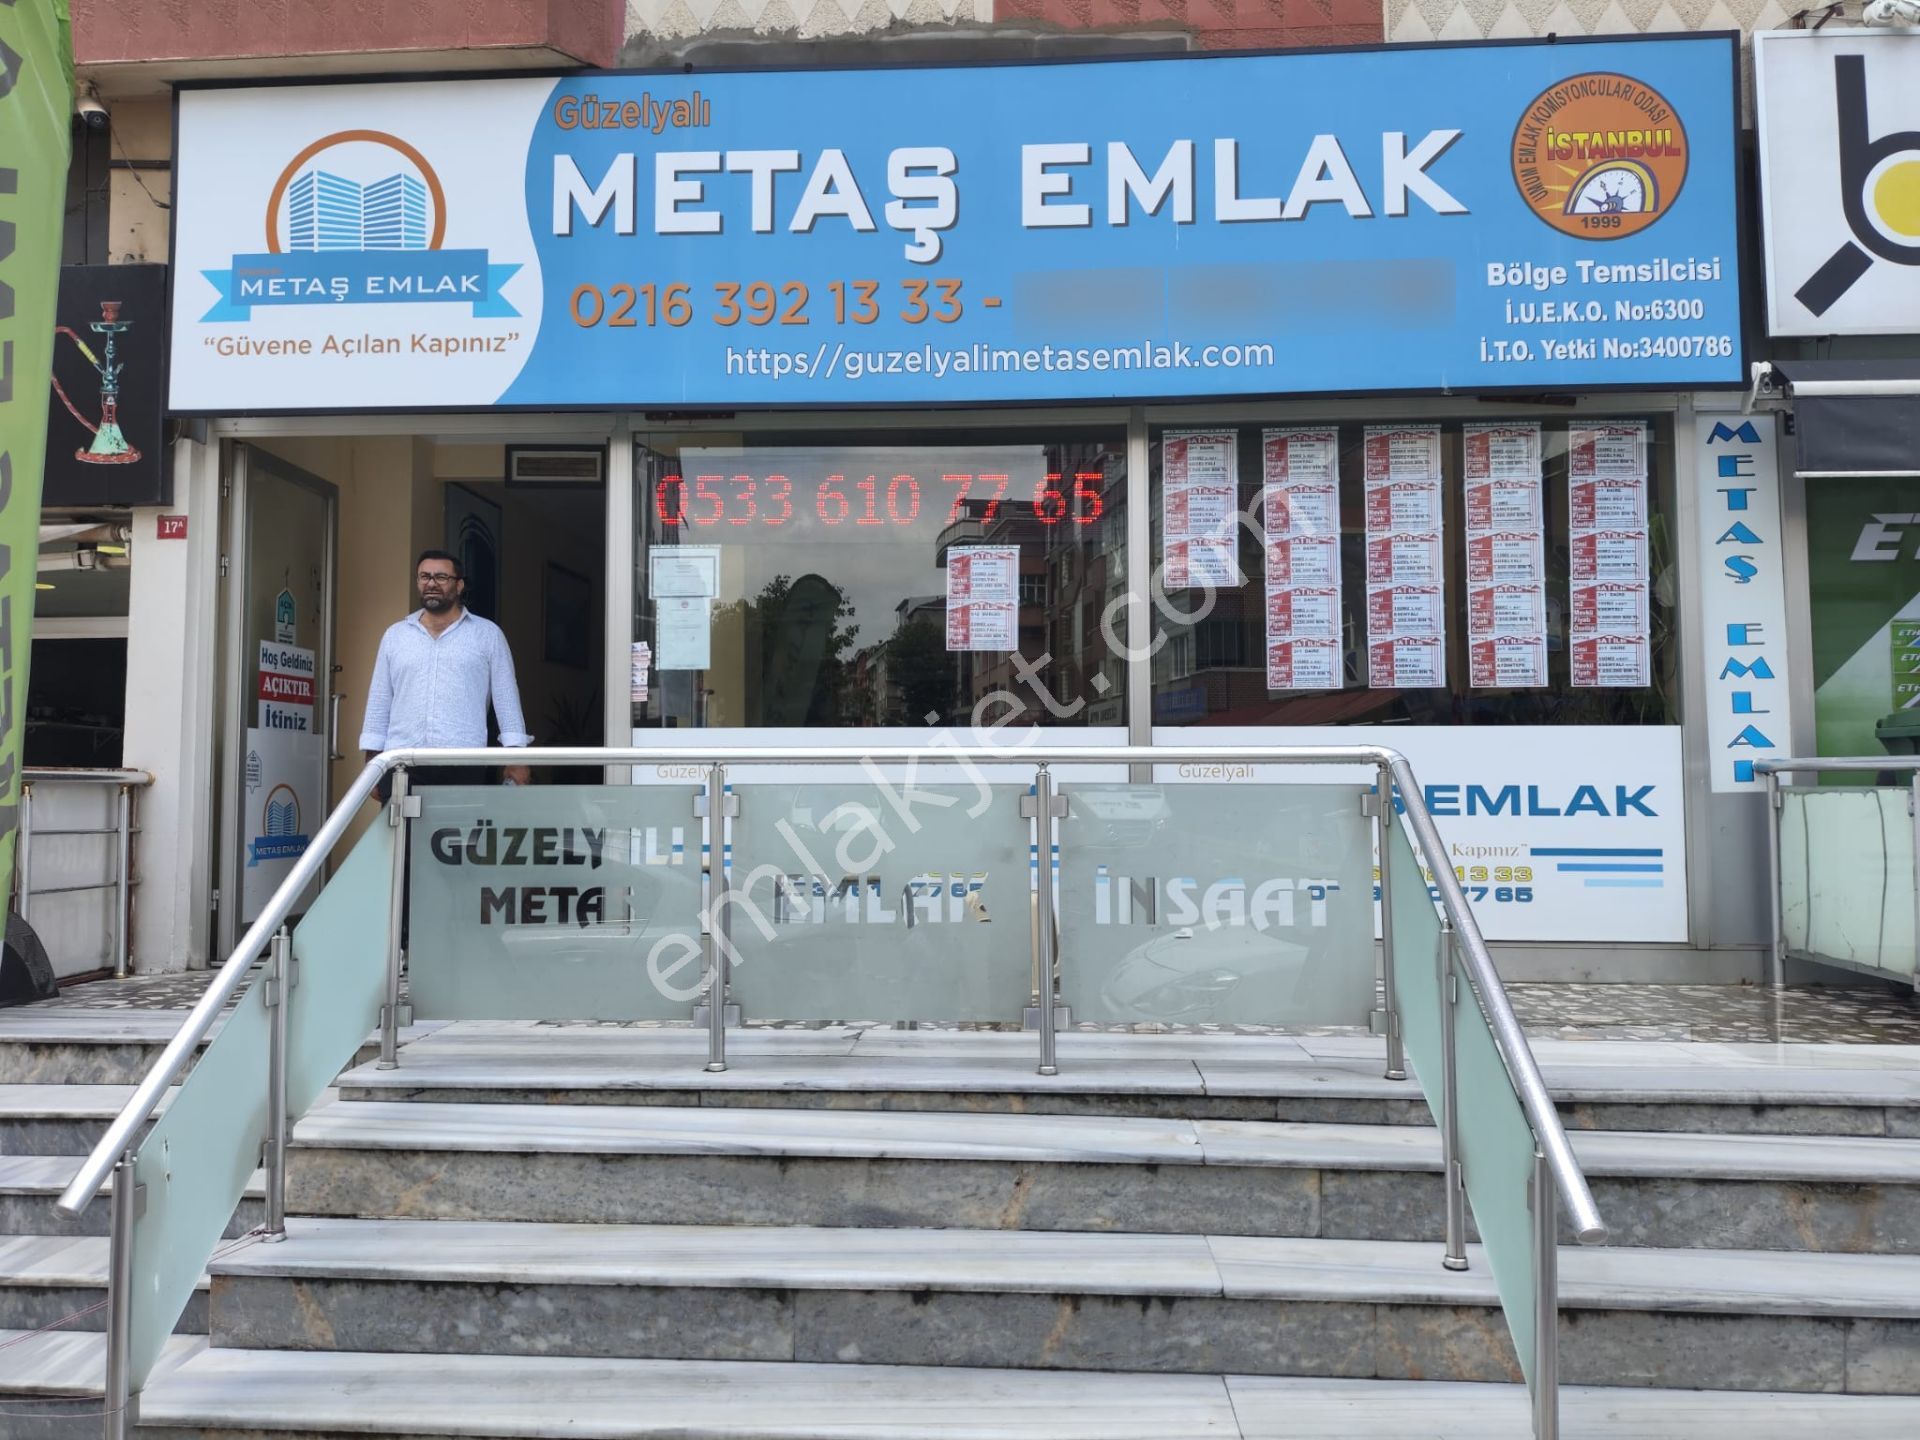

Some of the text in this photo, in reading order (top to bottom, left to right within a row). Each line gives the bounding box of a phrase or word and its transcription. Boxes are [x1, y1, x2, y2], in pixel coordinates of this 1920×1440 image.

[554, 90, 711, 135] Güzelyalı
[1518, 123, 1542, 165] EMLAK
[1530, 78, 1637, 127] KOMİSYONCULARI
[1633, 91, 1670, 126] ODASI
[1546, 126, 1681, 161] İSTANBUL
[552, 129, 1471, 264] METAŞ EMLAK
[1580, 215, 1622, 229] 1999
[240, 273, 481, 302] METAŞ EMLAK
[1487, 257, 1721, 291] Bölge Temsilcisi
[569, 281, 693, 328] 0216
[711, 280, 809, 327] 392
[828, 279, 881, 325] 13
[900, 278, 964, 324] 33
[1615, 298, 1705, 321] No:6300
[320, 334, 401, 358] Açılan
[725, 340, 1275, 379] https//guzelyalimetasemlak.com
[1540, 337, 1597, 360] Yetki
[1602, 335, 1733, 359] No:3400786
[656, 474, 793, 525] 0533
[816, 474, 920, 526] 610
[942, 473, 1009, 525] 77
[1033, 472, 1103, 525] 65
[1706, 420, 1765, 584] METAŞ
[261, 647, 313, 673] Hoş Geldiniz
[263, 675, 311, 698] AÇIKTIR
[265, 704, 307, 731] İtiniz
[1424, 785, 1660, 817] EMLAK
[1494, 865, 1533, 882] 33
[1494, 886, 1534, 903] 65
